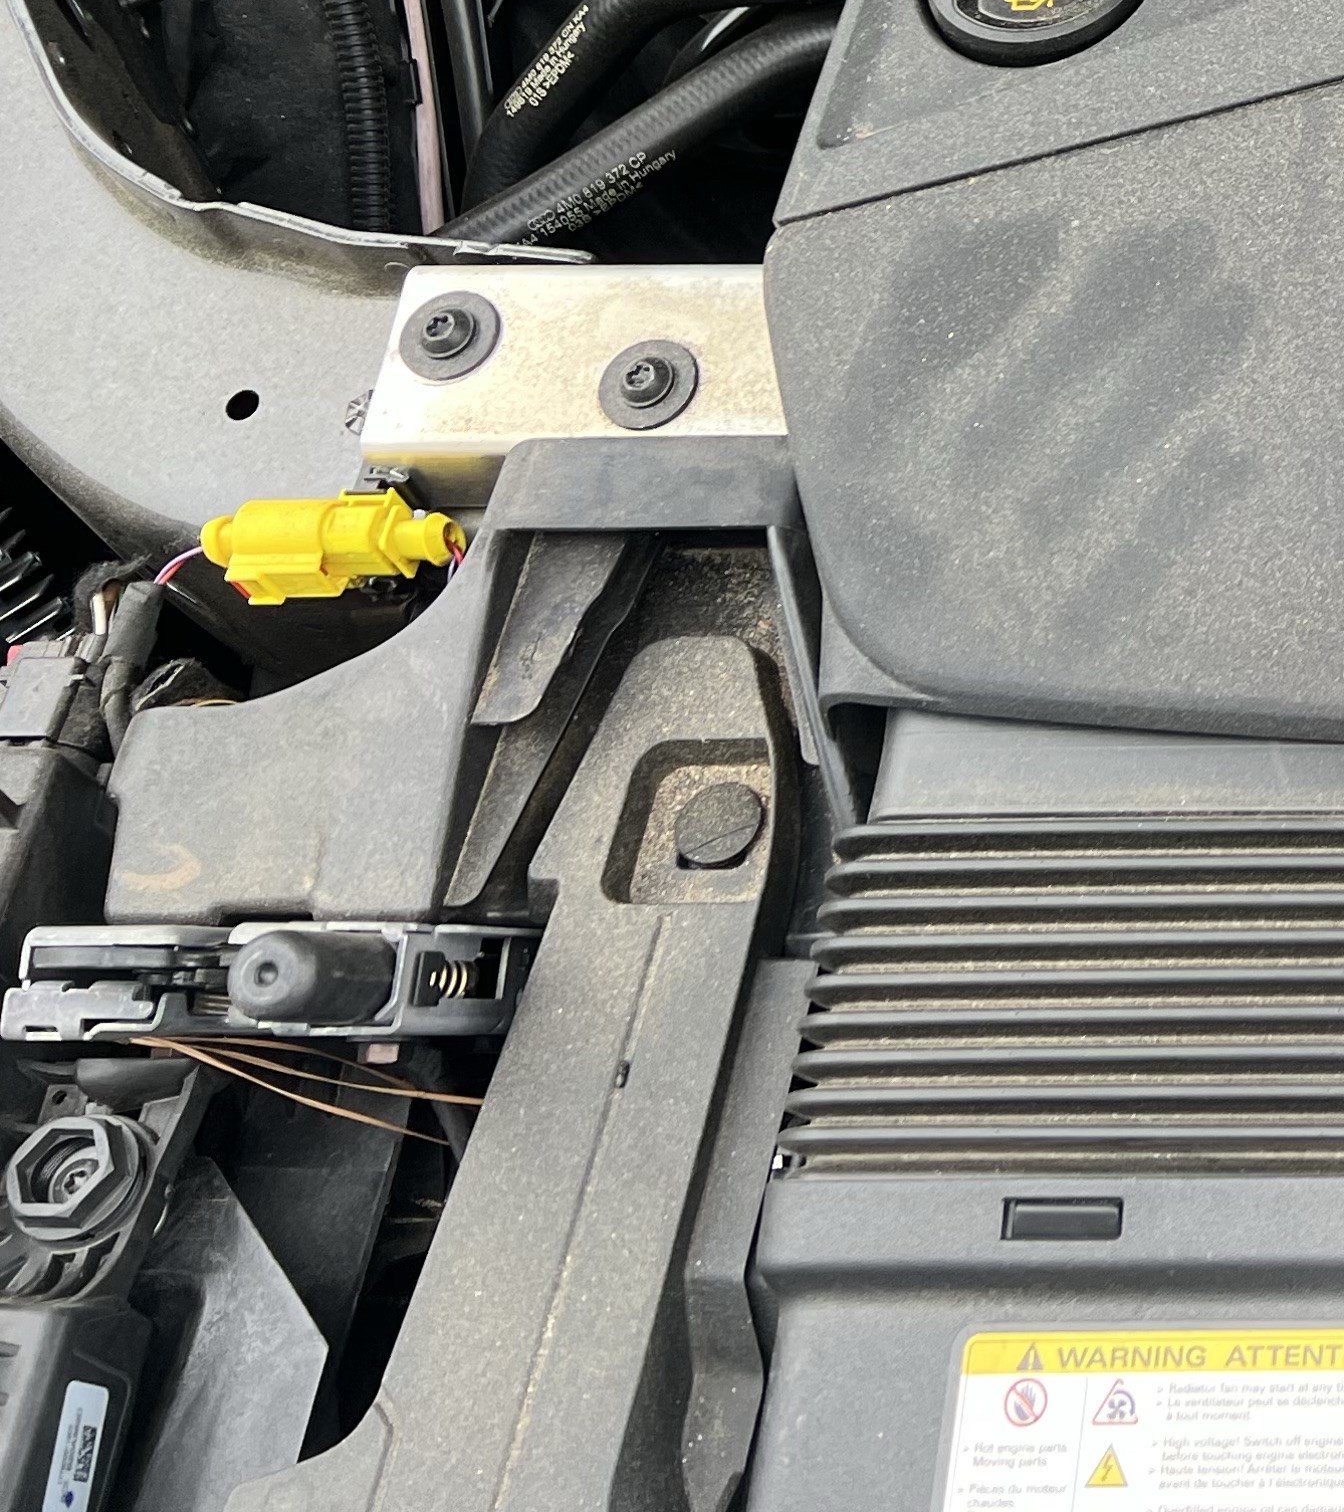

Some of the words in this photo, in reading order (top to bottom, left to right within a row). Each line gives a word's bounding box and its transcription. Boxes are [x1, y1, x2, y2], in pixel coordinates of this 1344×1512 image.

[555, 21, 586, 59] Hungary
[556, 193, 583, 215] 4M0
[605, 163, 630, 184] 372
[628, 151, 647, 169] CP
[583, 188, 616, 212] Made
[616, 179, 631, 192] in
[629, 149, 677, 184] Hungary
[1057, 1345, 1207, 1368] WARNING
[1241, 1384, 1265, 1395] may
[1269, 1383, 1295, 1393] start
[1312, 1384, 1332, 1394] any
[1163, 1437, 1190, 1450] High
[1244, 1436, 1282, 1447] Switch
[1285, 1435, 1301, 1447] off
[1304, 1437, 1344, 1449] engine
[997, 1444, 1035, 1455] engine
[1039, 1444, 1067, 1454] parts
[1162, 1450, 1199, 1462] before
[1202, 1449, 1253, 1463] touching
[1256, 1450, 1295, 1463] engine
[973, 1456, 1016, 1468] Moving
[1018, 1457, 1047, 1468] parts
[1160, 1464, 1193, 1475] Haute
[1026, 1485, 1067, 1494] moteur
[1211, 1478, 1255, 1489] toucher
